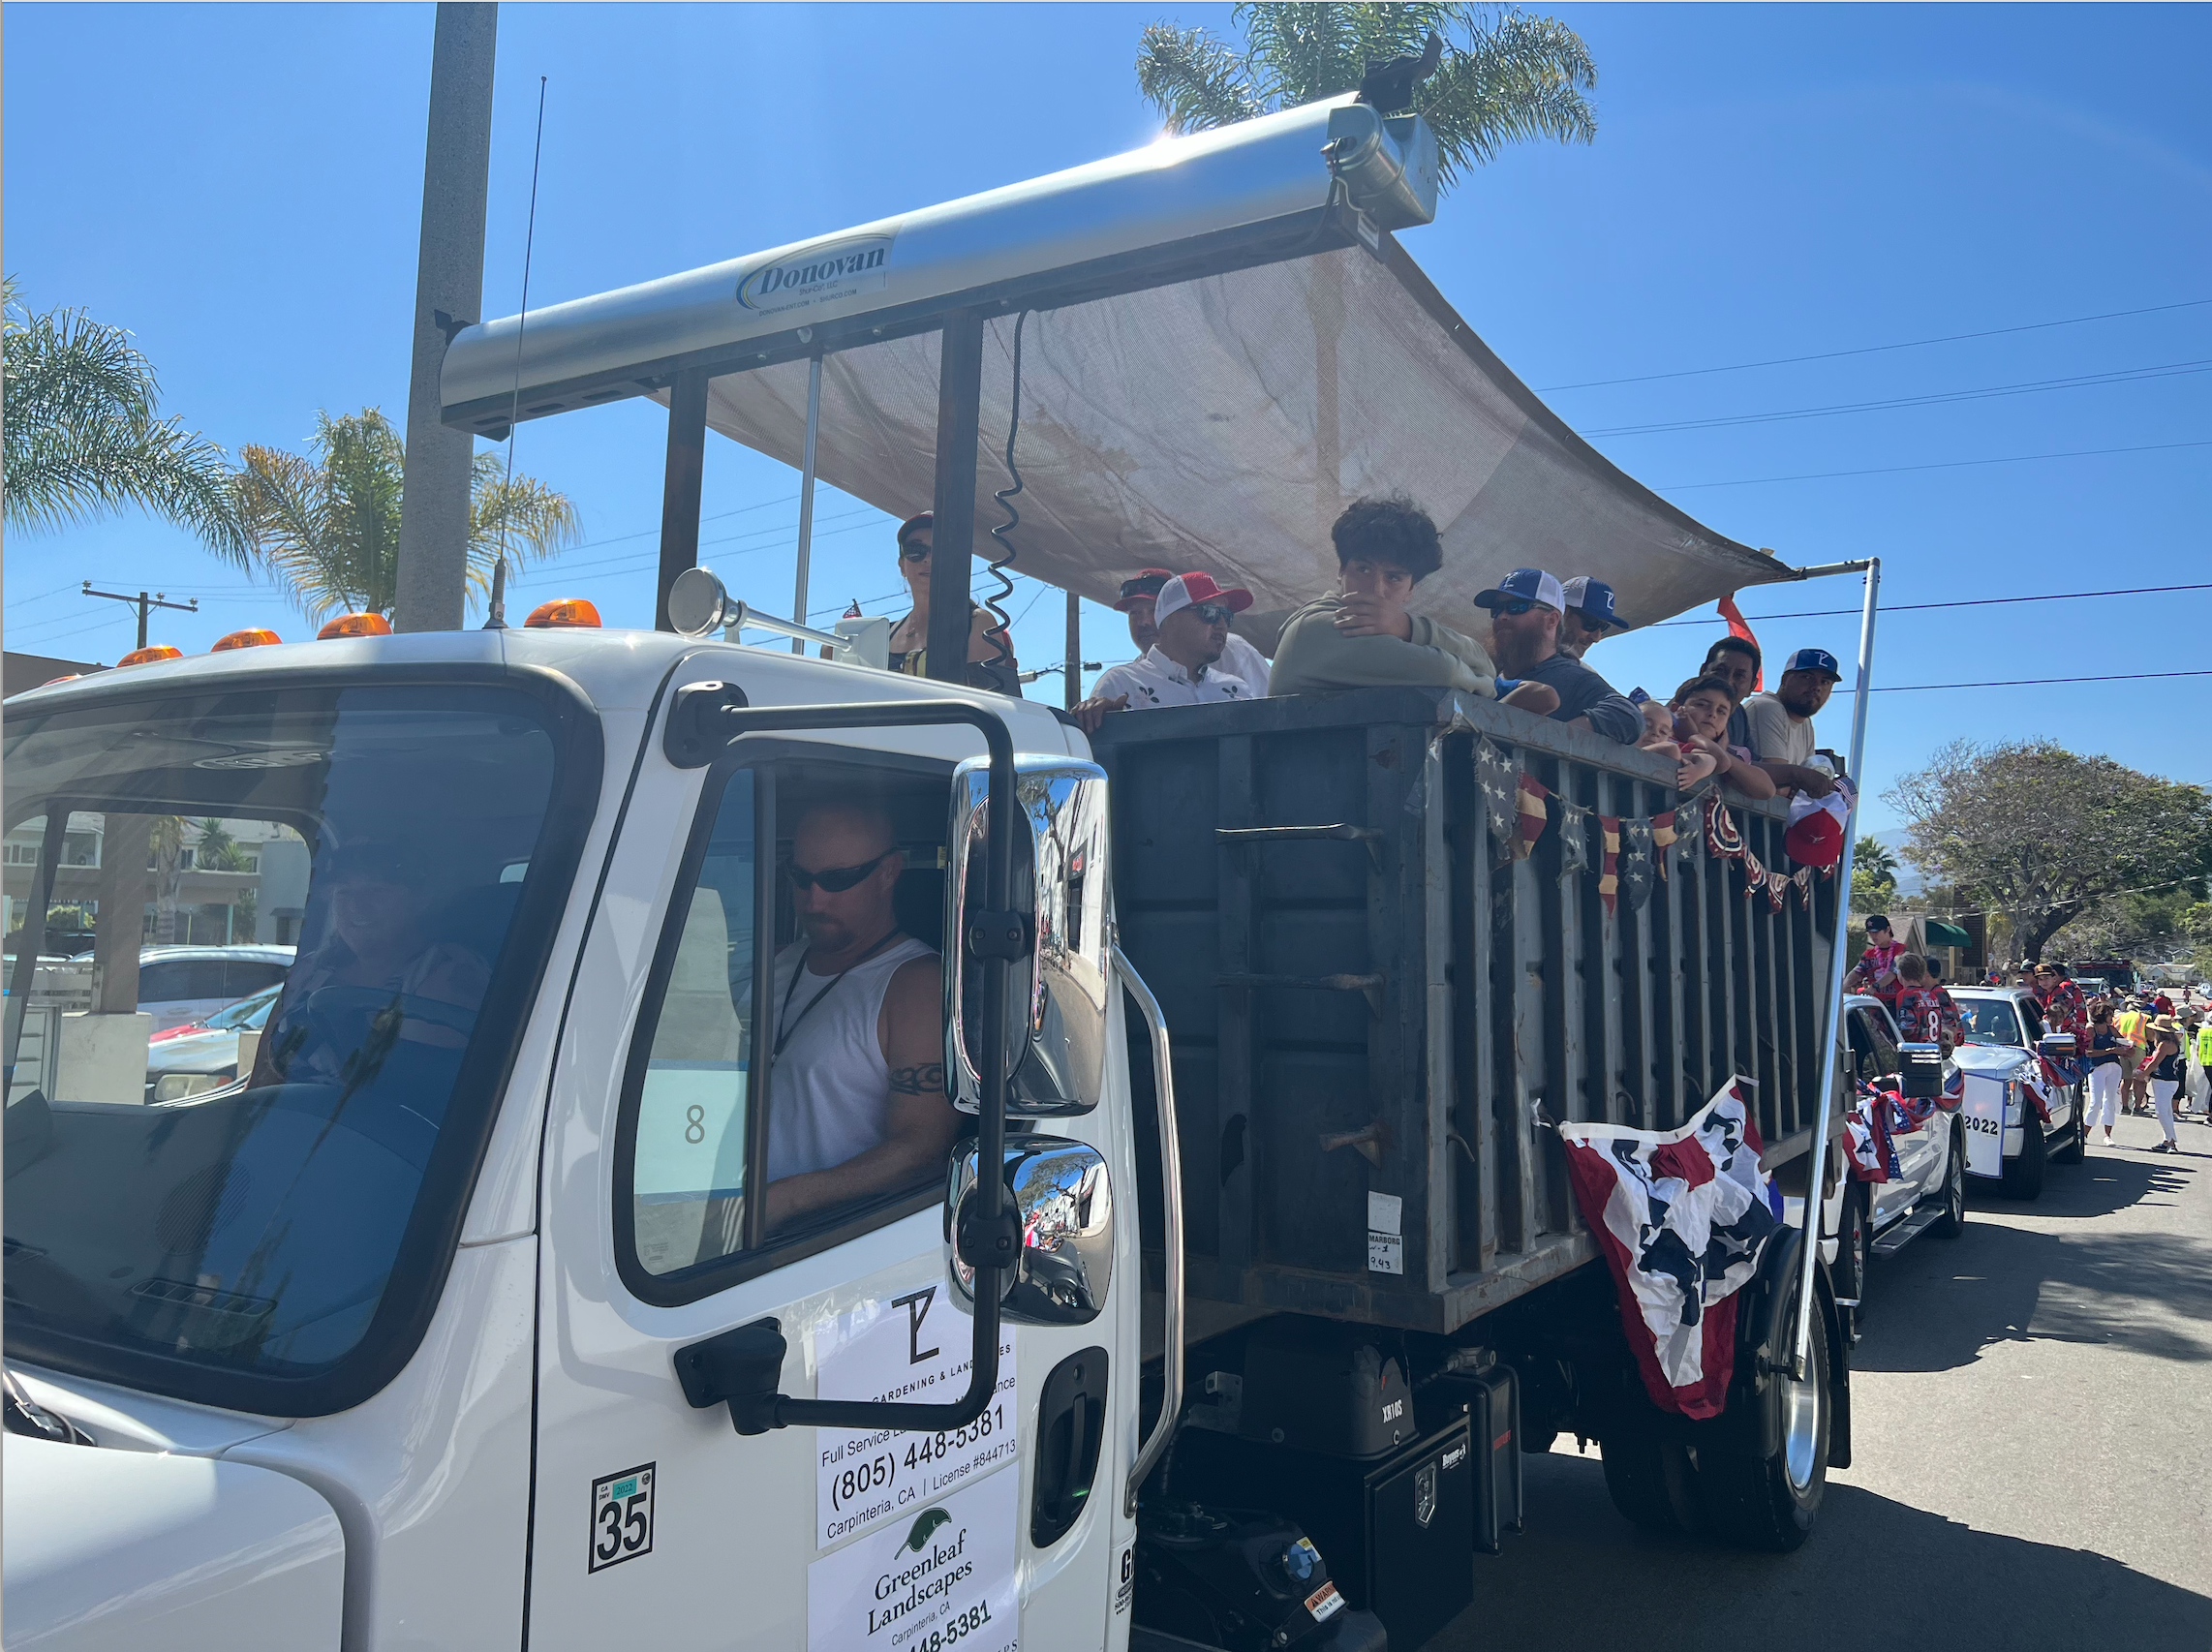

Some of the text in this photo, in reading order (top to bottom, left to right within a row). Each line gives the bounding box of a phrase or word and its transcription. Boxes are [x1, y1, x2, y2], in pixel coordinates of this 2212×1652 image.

[758, 247, 884, 294] Donovan
[758, 289, 857, 317] DONOVAN-ENT.COM SHURCO.COM
[1927, 1010, 1939, 1042] 8
[685, 1104, 705, 1145] 8
[1964, 1116, 1998, 1136] 2022
[1369, 1236, 1400, 1245] MARBORG
[872, 1375, 936, 1404] GARDENING
[939, 1371, 946, 1381] &
[1382, 1398, 1403, 1423] XR10S
[822, 1445, 844, 1467] Full
[847, 1428, 890, 1456] Service
[832, 1403, 1003, 1512] (805) 448-5381
[599, 1492, 610, 1501] DMV
[616, 1483, 633, 1495] 2022
[826, 1439, 1016, 1539] Carpinteria, CA License #844713
[598, 1491, 647, 1560] 35
[875, 1528, 967, 1601] Greenleaf
[867, 1560, 972, 1637] Landscapes
[1316, 1605, 1329, 1615] This
[891, 1601, 951, 1646] Carpinteria, CA
